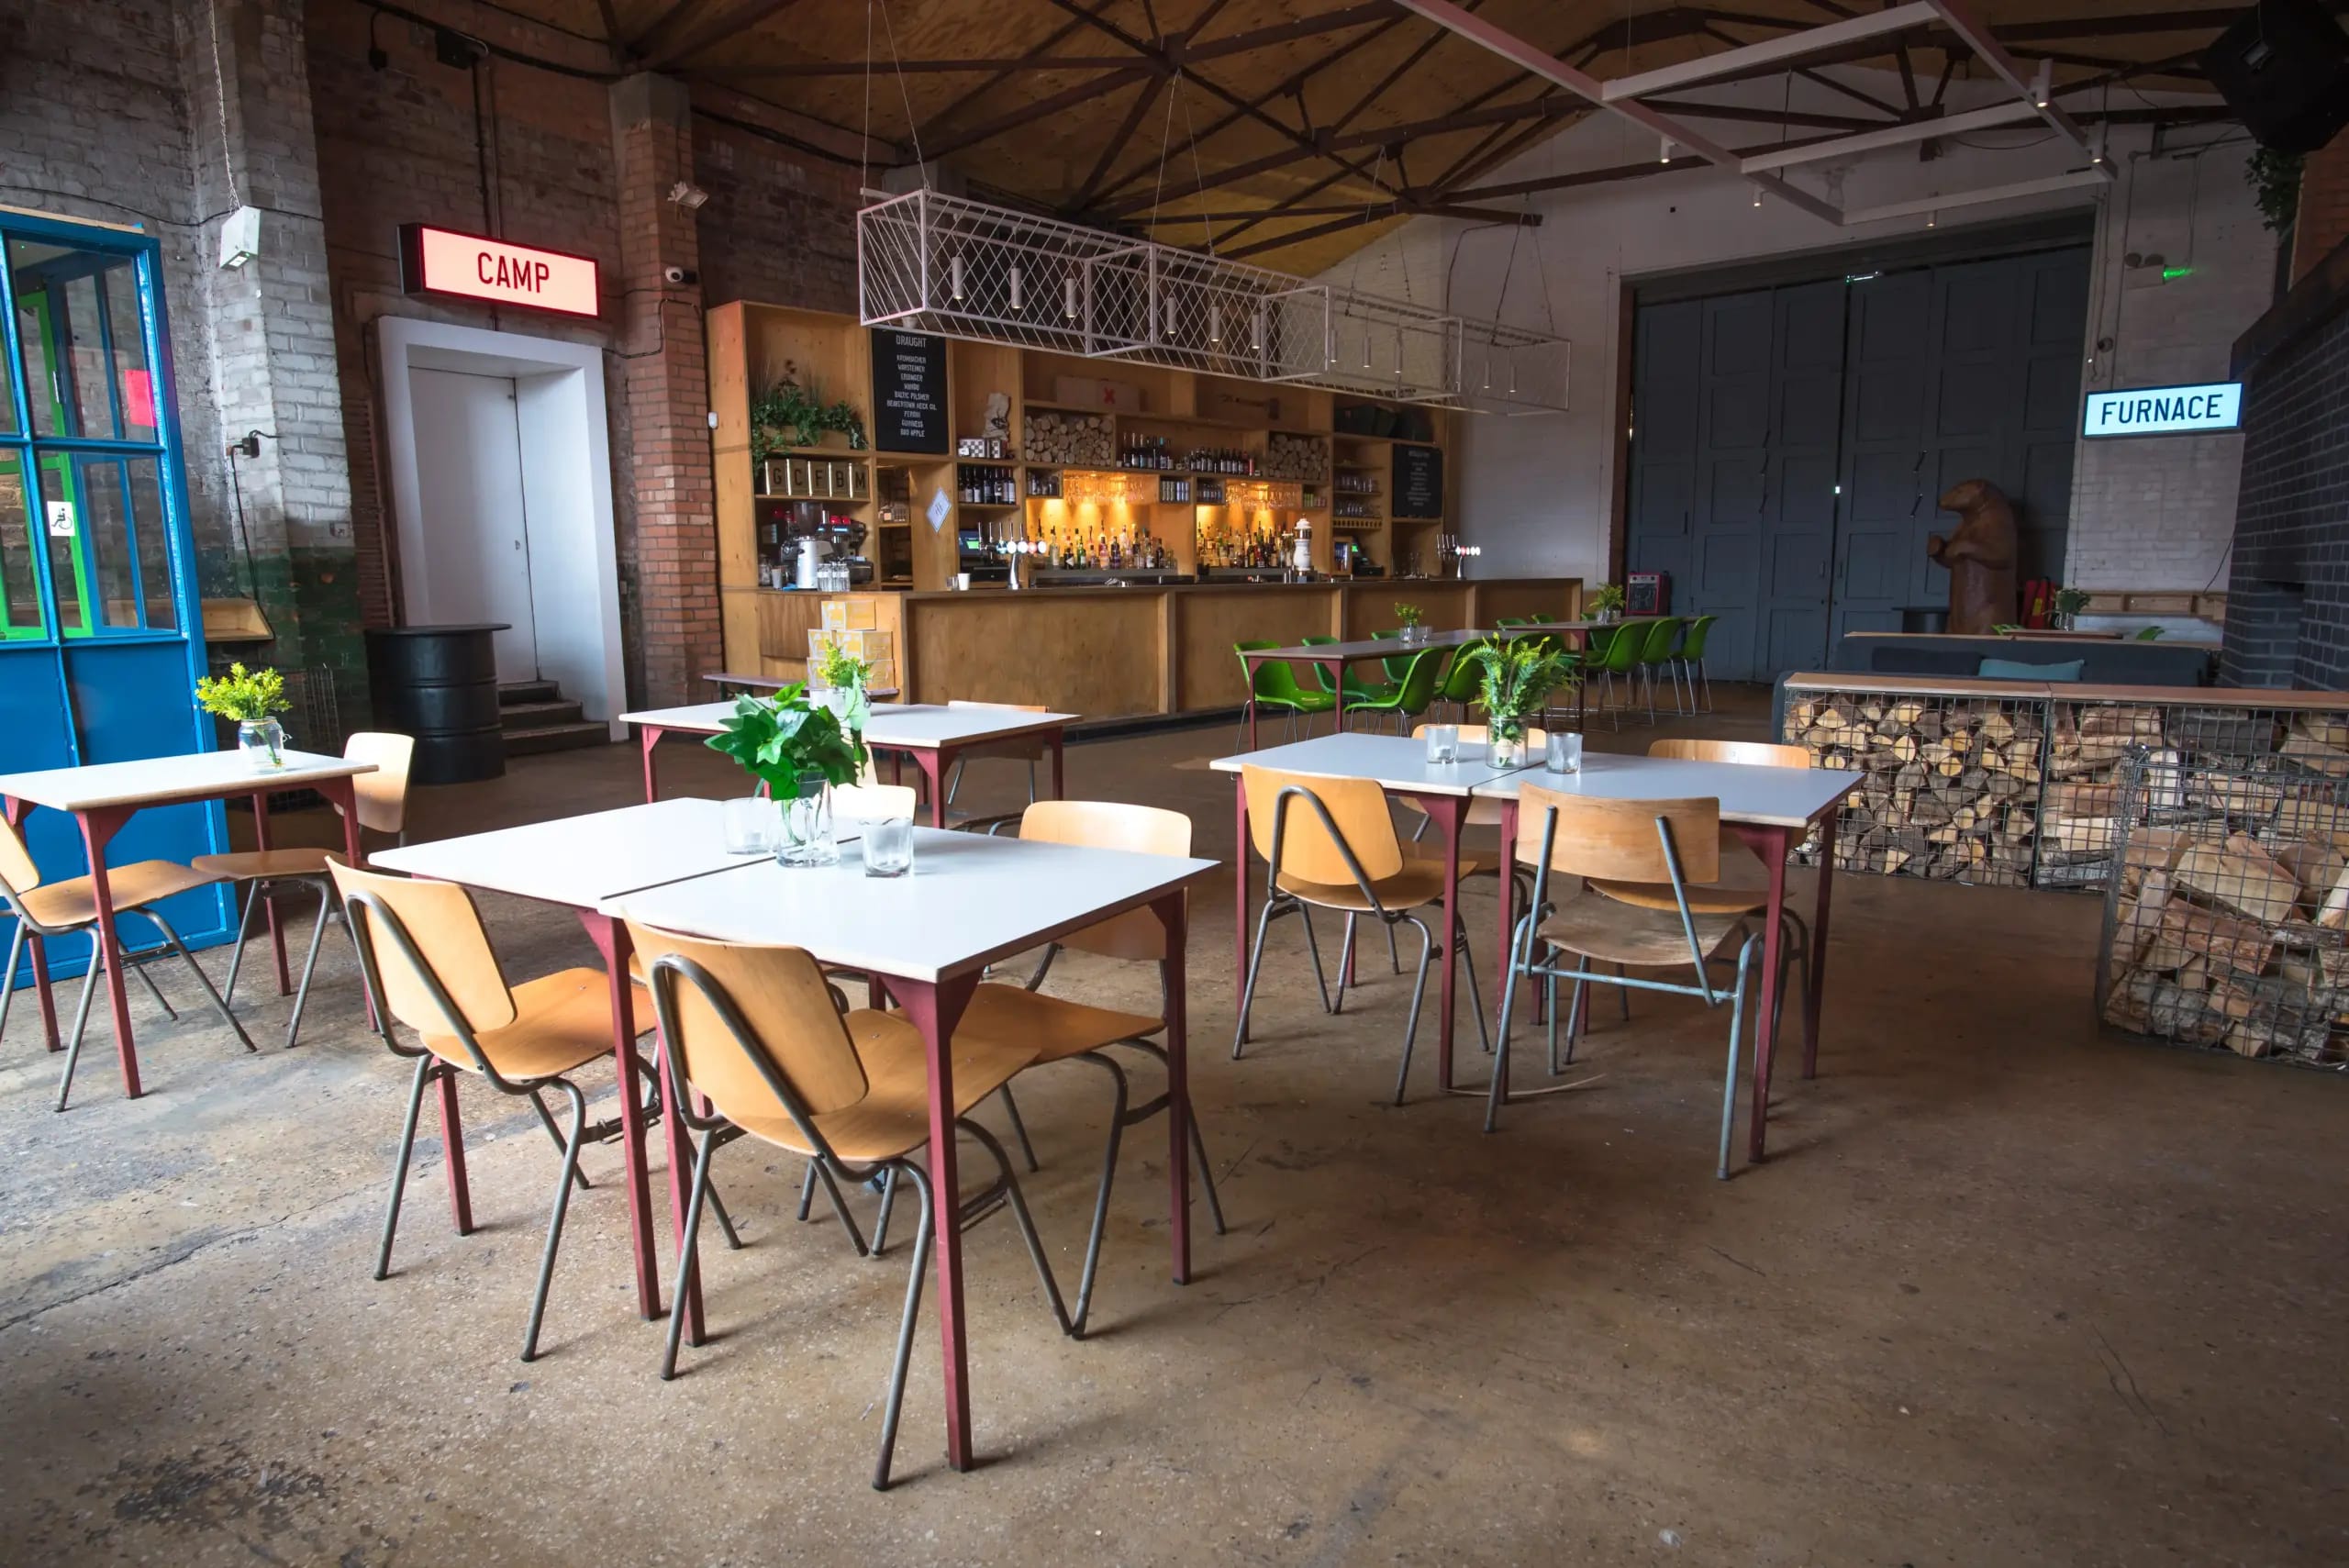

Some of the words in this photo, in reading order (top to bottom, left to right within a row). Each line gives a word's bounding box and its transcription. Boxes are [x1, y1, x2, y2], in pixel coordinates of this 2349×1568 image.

[477, 251, 550, 294] CAMP
[896, 334, 927, 348] DRAUGHT
[2101, 394, 2223, 426] FURNACE
[773, 468, 782, 484] G
[795, 469, 802, 485] C
[815, 470, 823, 486] F
[855, 471, 865, 488] M
